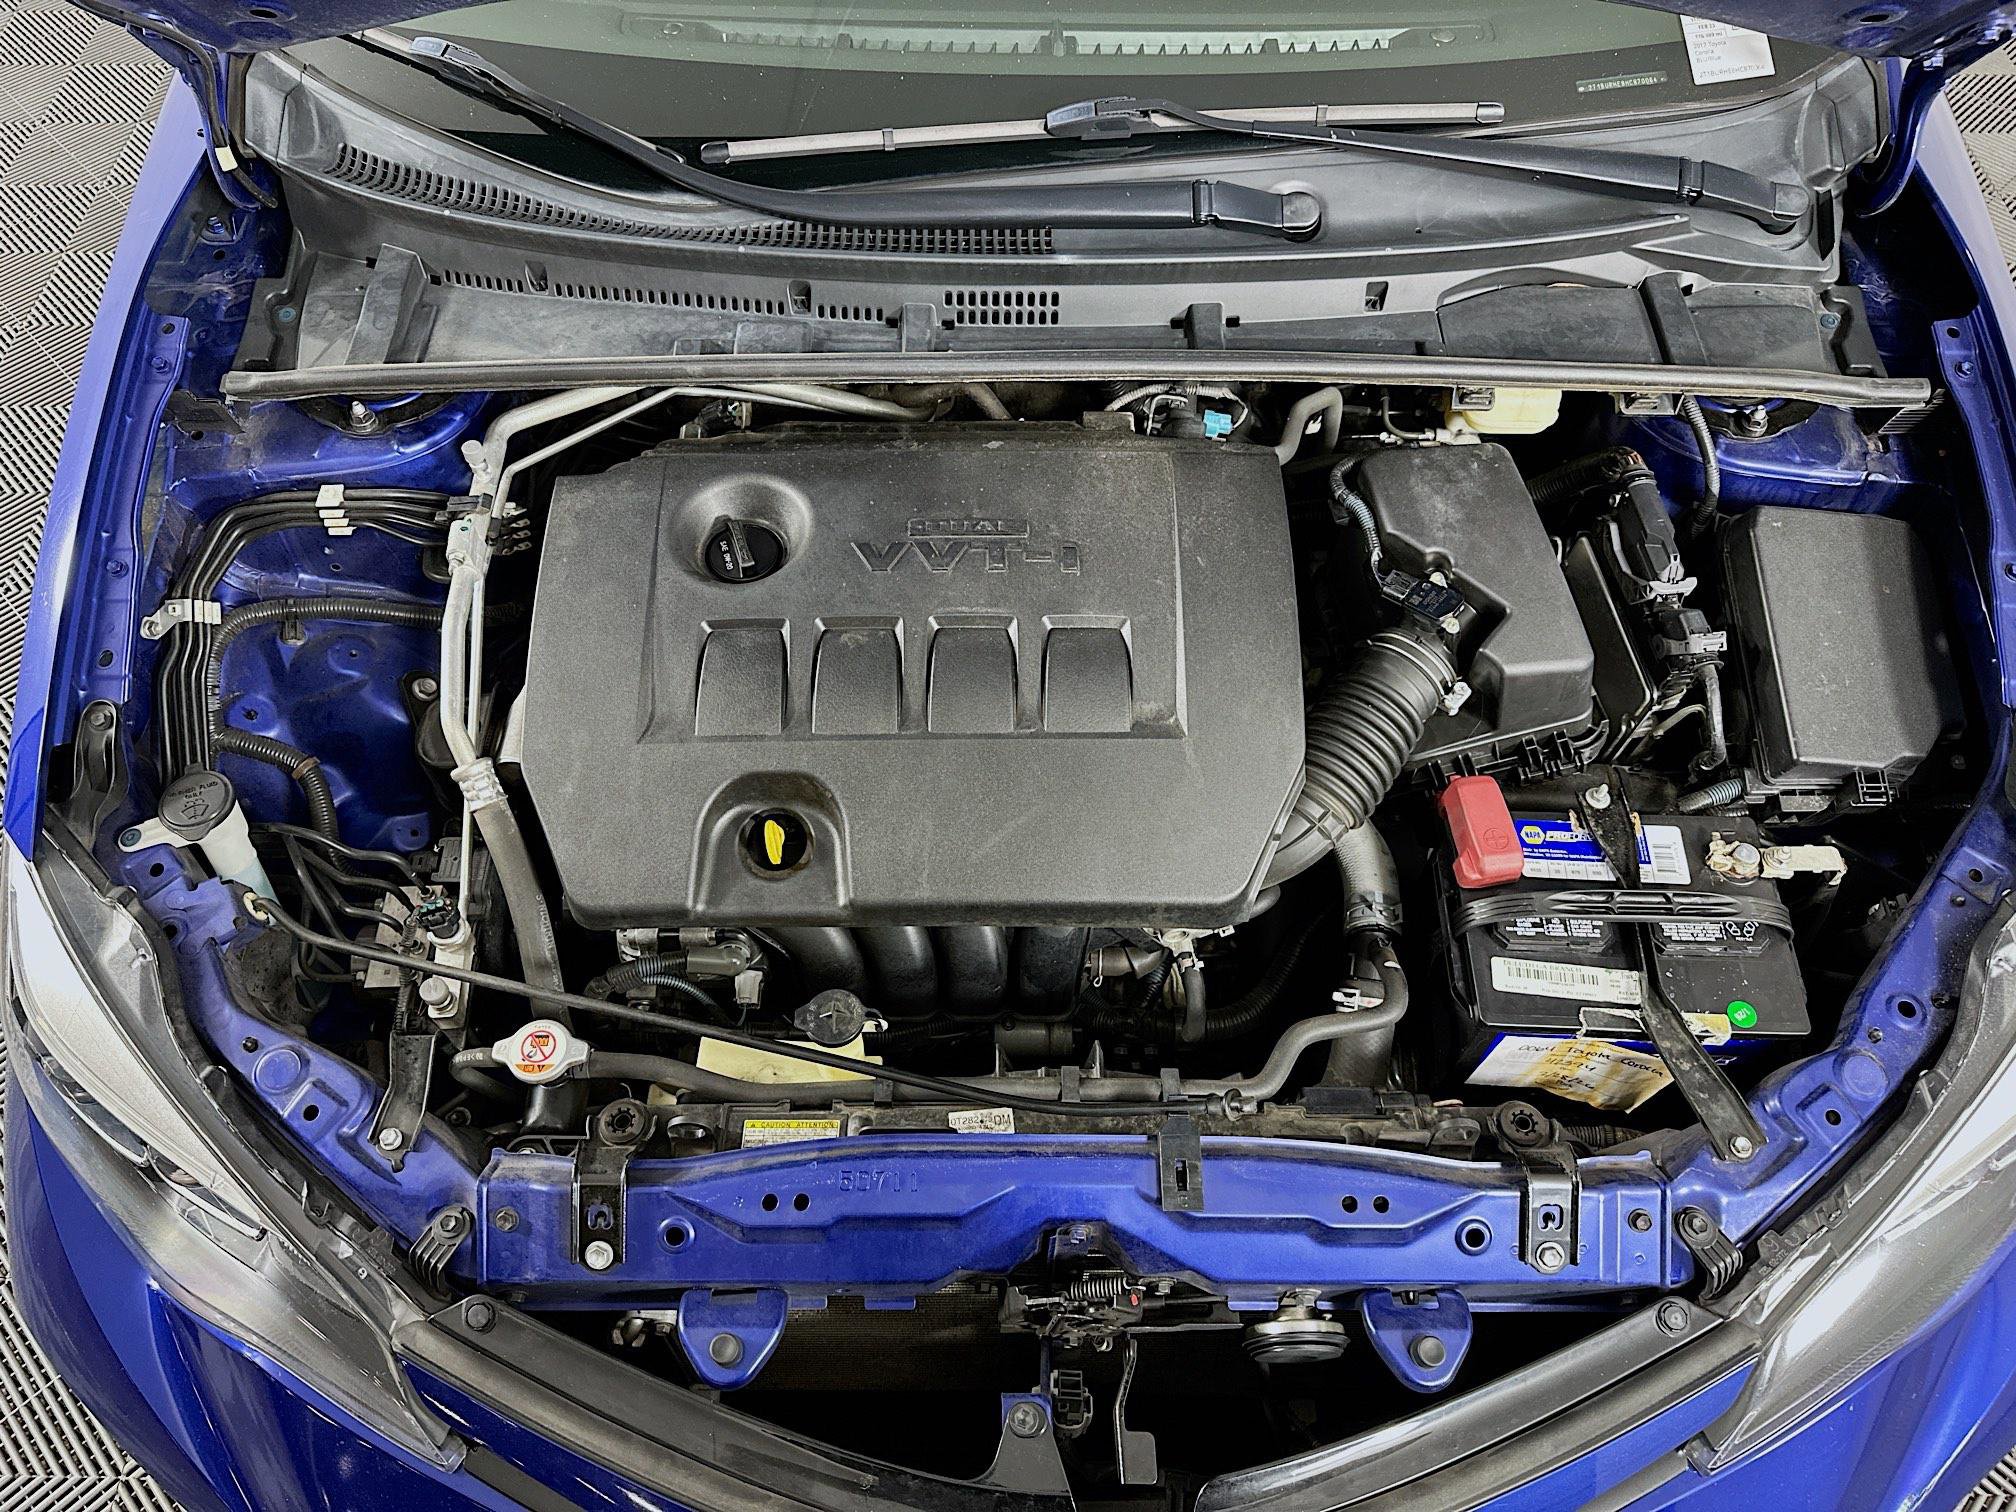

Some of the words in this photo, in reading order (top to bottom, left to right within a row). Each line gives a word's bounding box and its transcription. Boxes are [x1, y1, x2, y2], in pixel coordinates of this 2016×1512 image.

[719, 540, 729, 552] SAE
[1524, 831, 1541, 839] NAPA
[1567, 1046, 1612, 1060] Toyota
